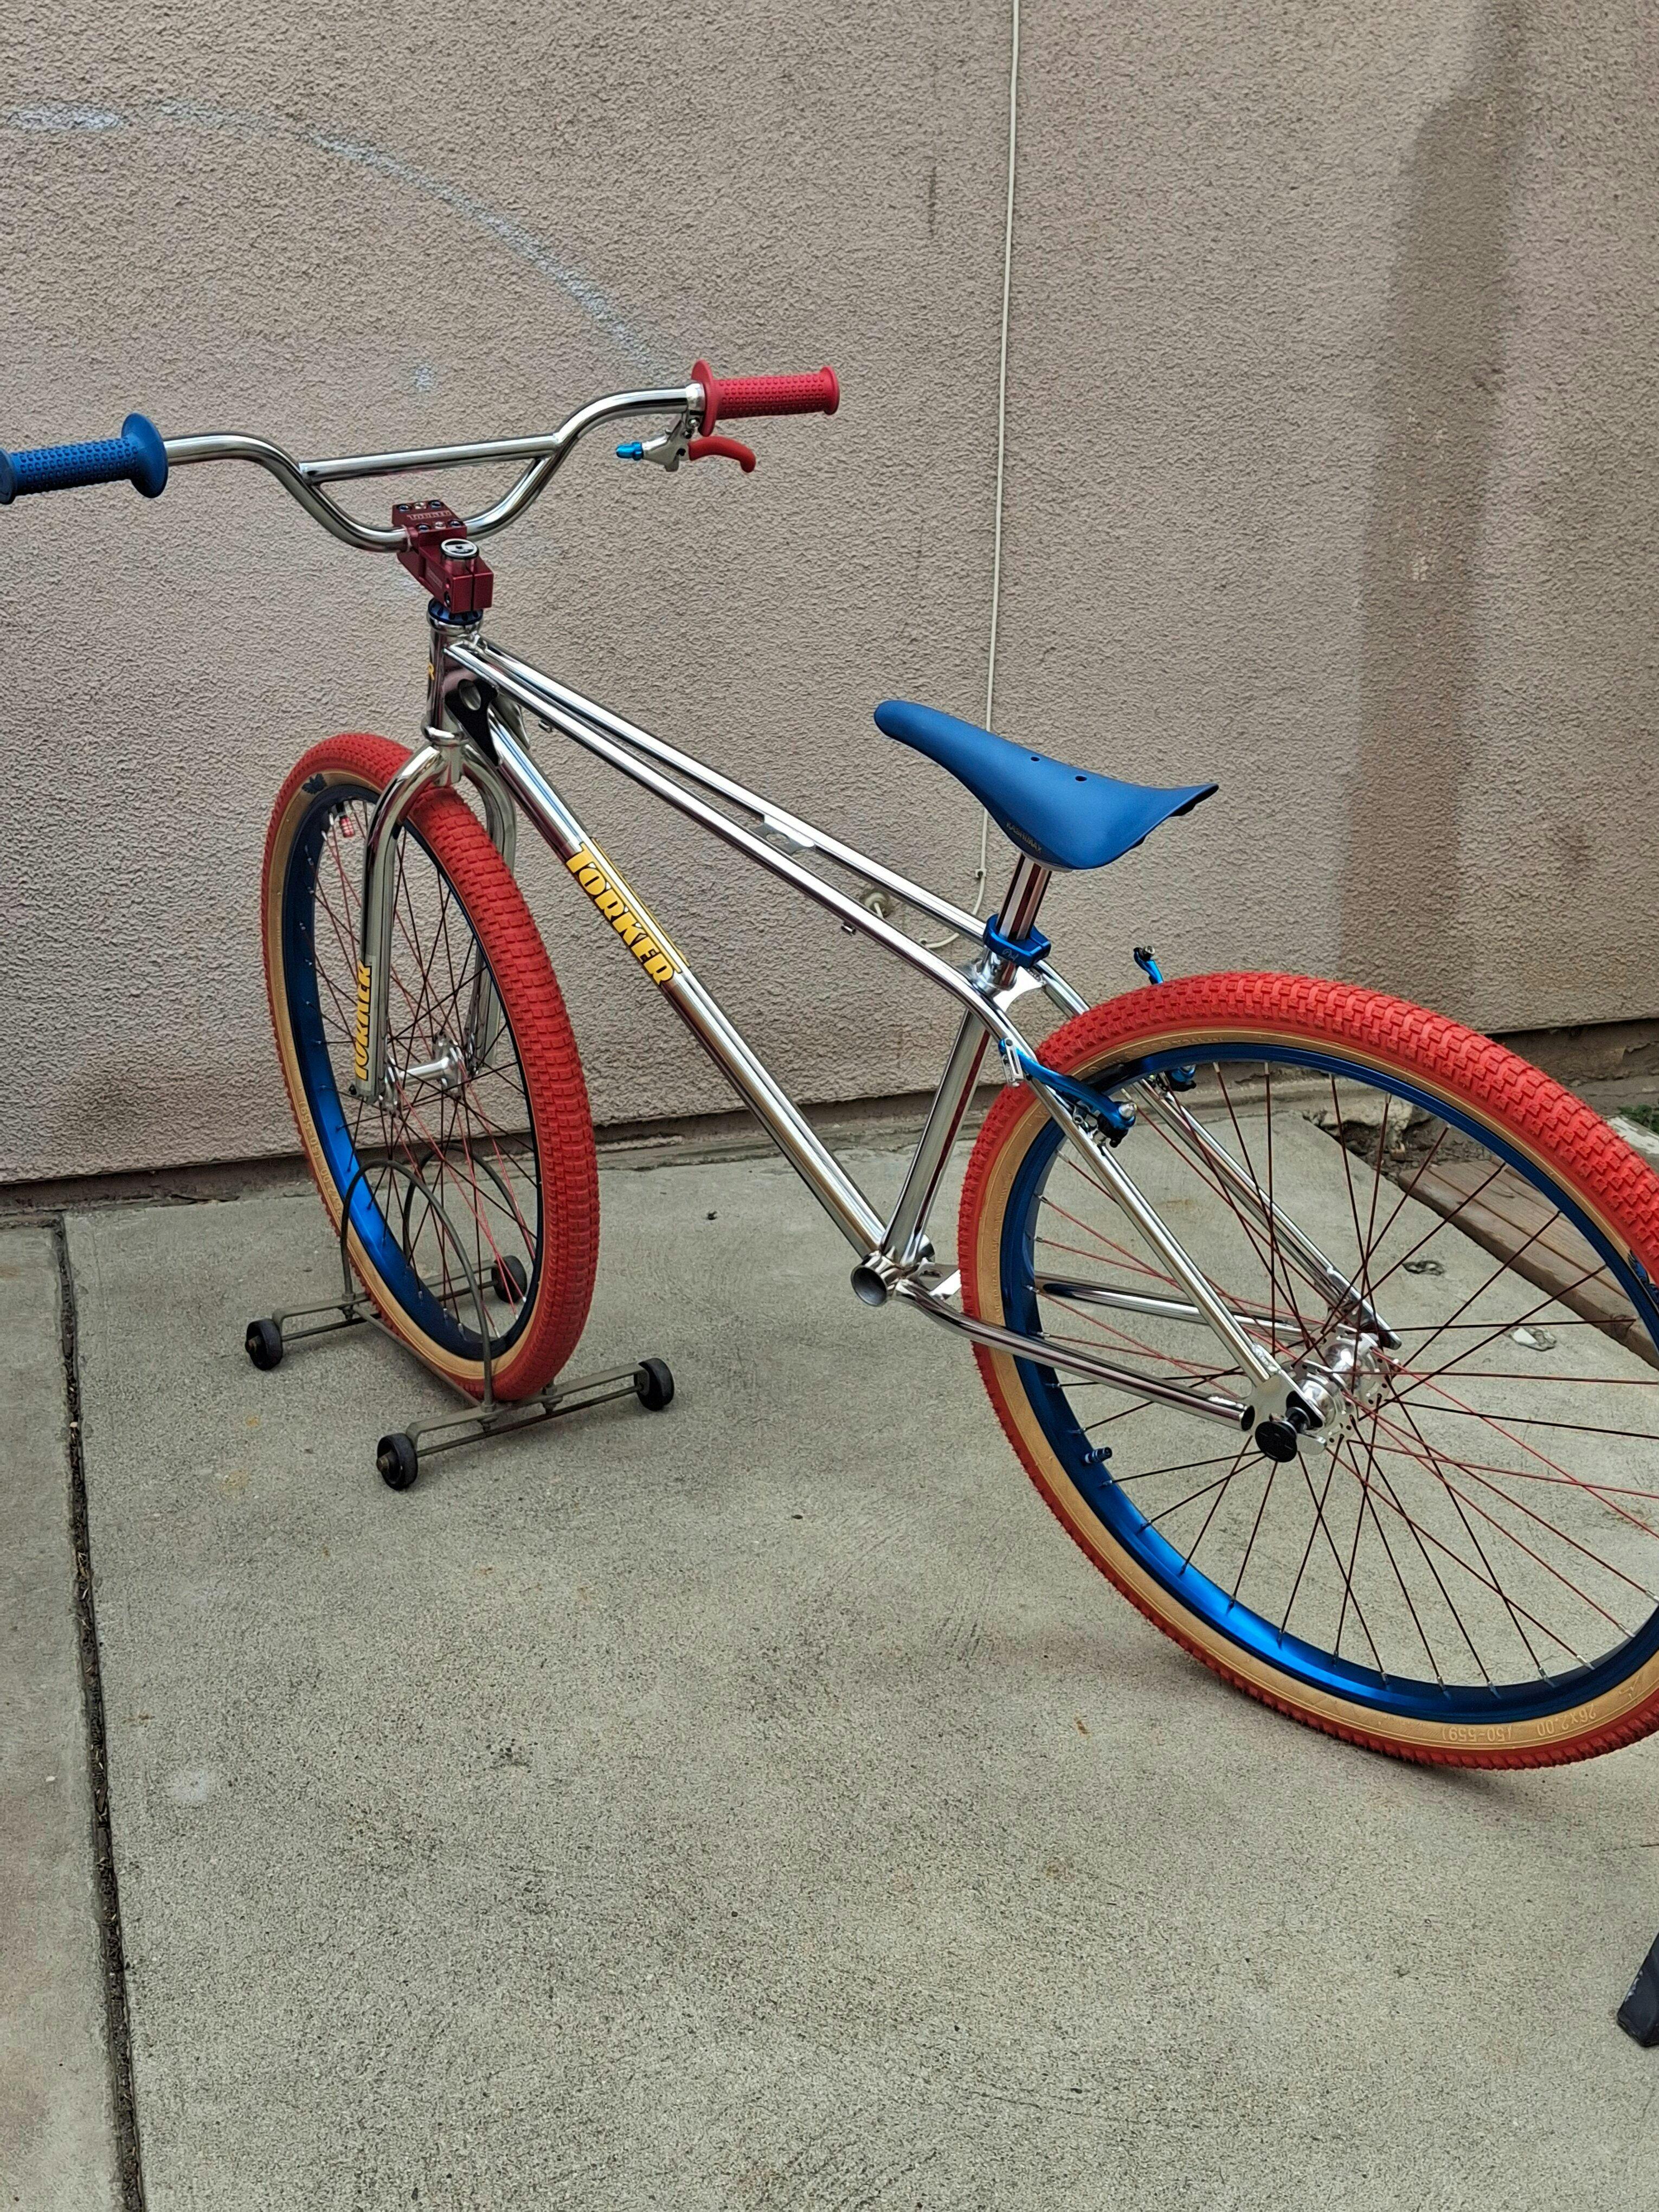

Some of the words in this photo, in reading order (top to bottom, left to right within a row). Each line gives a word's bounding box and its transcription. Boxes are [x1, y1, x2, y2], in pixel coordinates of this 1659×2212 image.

[565, 841, 682, 986] TORKER
[1441, 1725, 1513, 1743] (50-559)
[1536, 1703, 1597, 1735] 26x2.00
